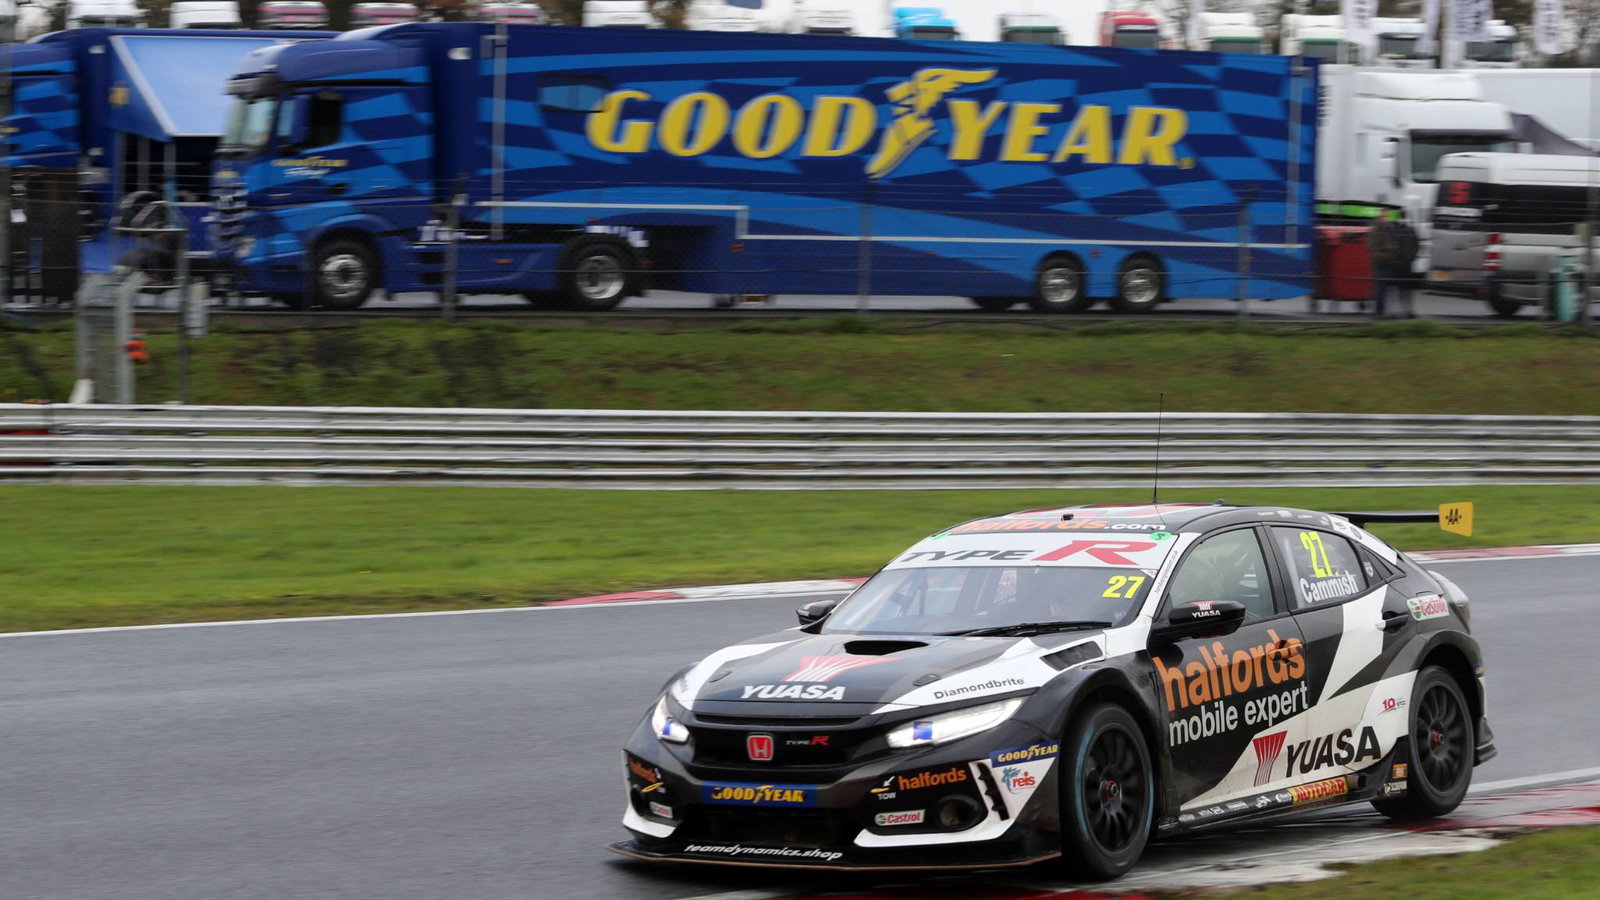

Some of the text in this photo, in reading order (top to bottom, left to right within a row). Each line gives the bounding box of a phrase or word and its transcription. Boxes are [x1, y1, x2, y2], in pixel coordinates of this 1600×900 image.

[900, 540, 1157, 565] TYPE R
[1300, 531, 1333, 578] 27
[1102, 575, 1146, 599] 27
[1300, 569, 1359, 603] Cammish
[1191, 609, 1221, 619] YUASA
[1152, 629, 1305, 712] halfords
[741, 685, 846, 700] YUASA
[933, 678, 1024, 699] Diamondbrite
[1169, 681, 1308, 747] mobile expert
[810, 736, 829, 746] R
[1286, 726, 1381, 778] YUASA
[898, 768, 967, 791] halfords
[1012, 772, 1036, 788] reis
[1295, 778, 1345, 801] AUTOCAR
[877, 792, 896, 800] TOW
[886, 812, 921, 825] Castrol
[684, 844, 843, 861] teamdynamics.shop
